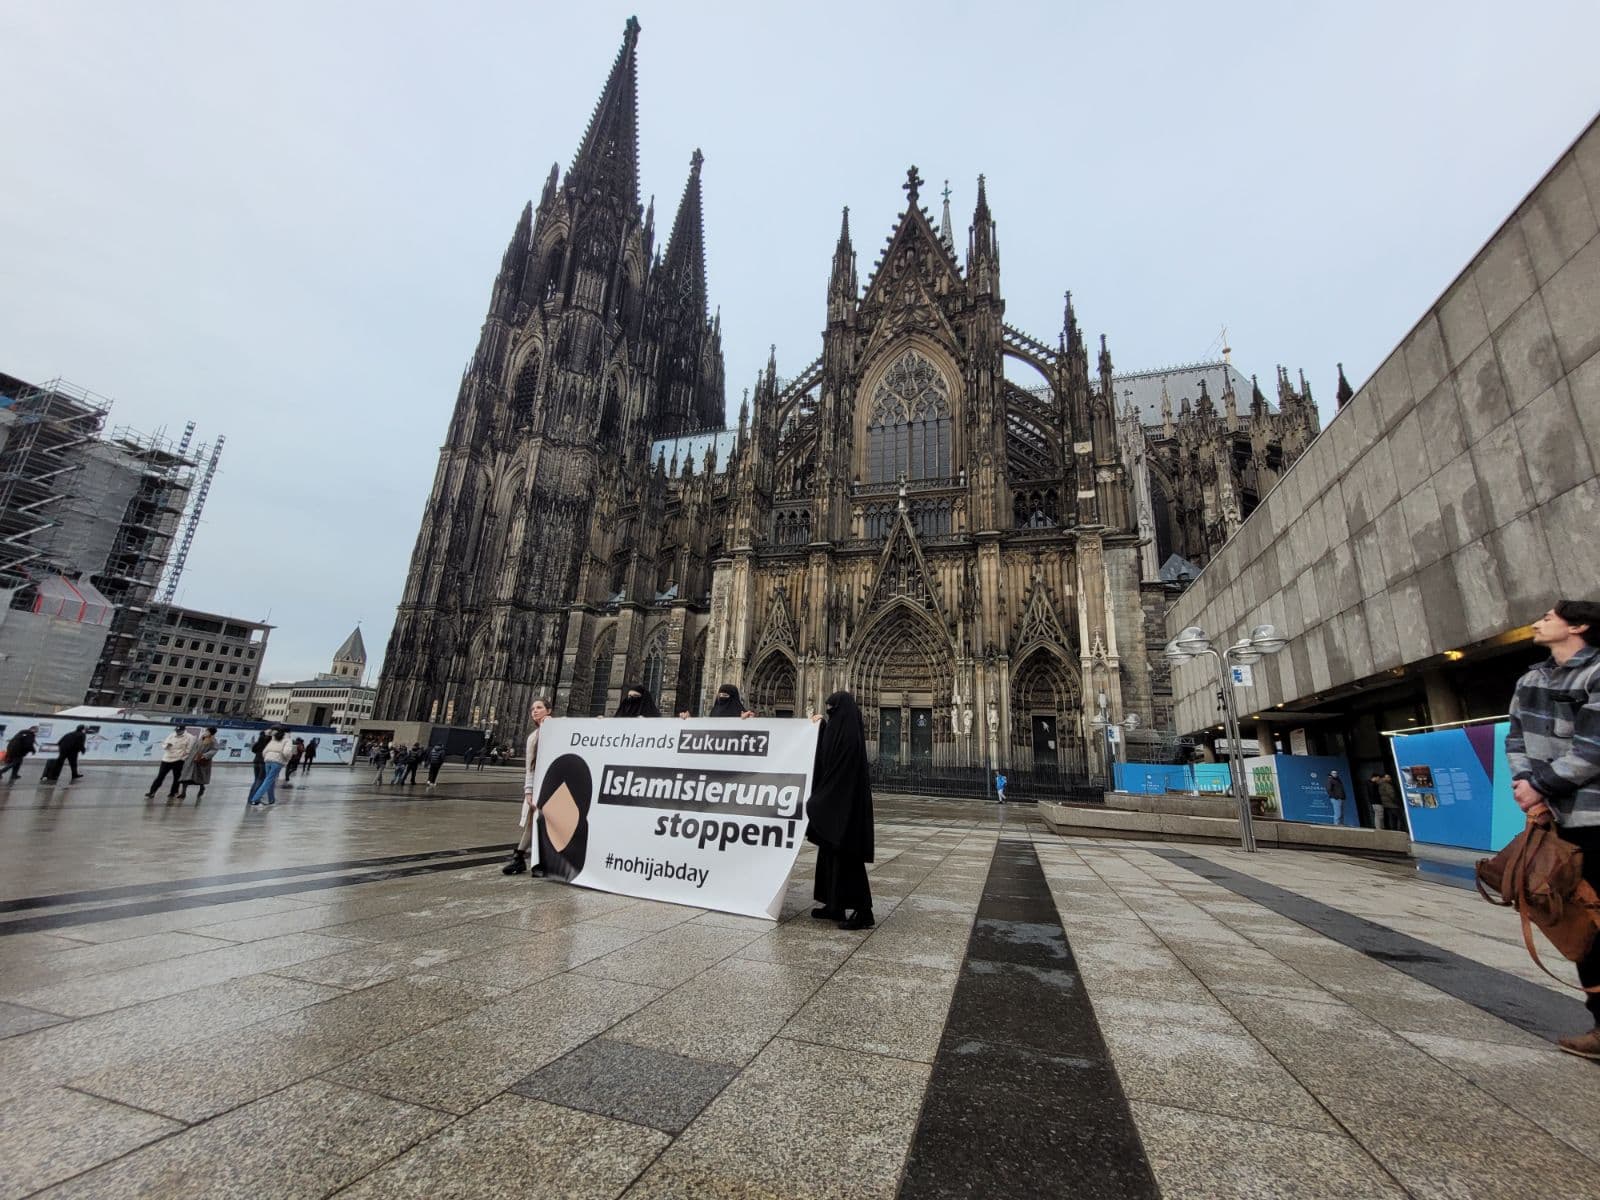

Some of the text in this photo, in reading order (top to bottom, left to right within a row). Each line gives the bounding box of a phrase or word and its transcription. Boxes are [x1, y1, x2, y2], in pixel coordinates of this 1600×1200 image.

[570, 732, 767, 754] Deutschlands Zukunft?
[603, 770, 800, 817] Islamisierung
[655, 814, 796, 851] stoppen!
[605, 853, 709, 888] #nohijabday
